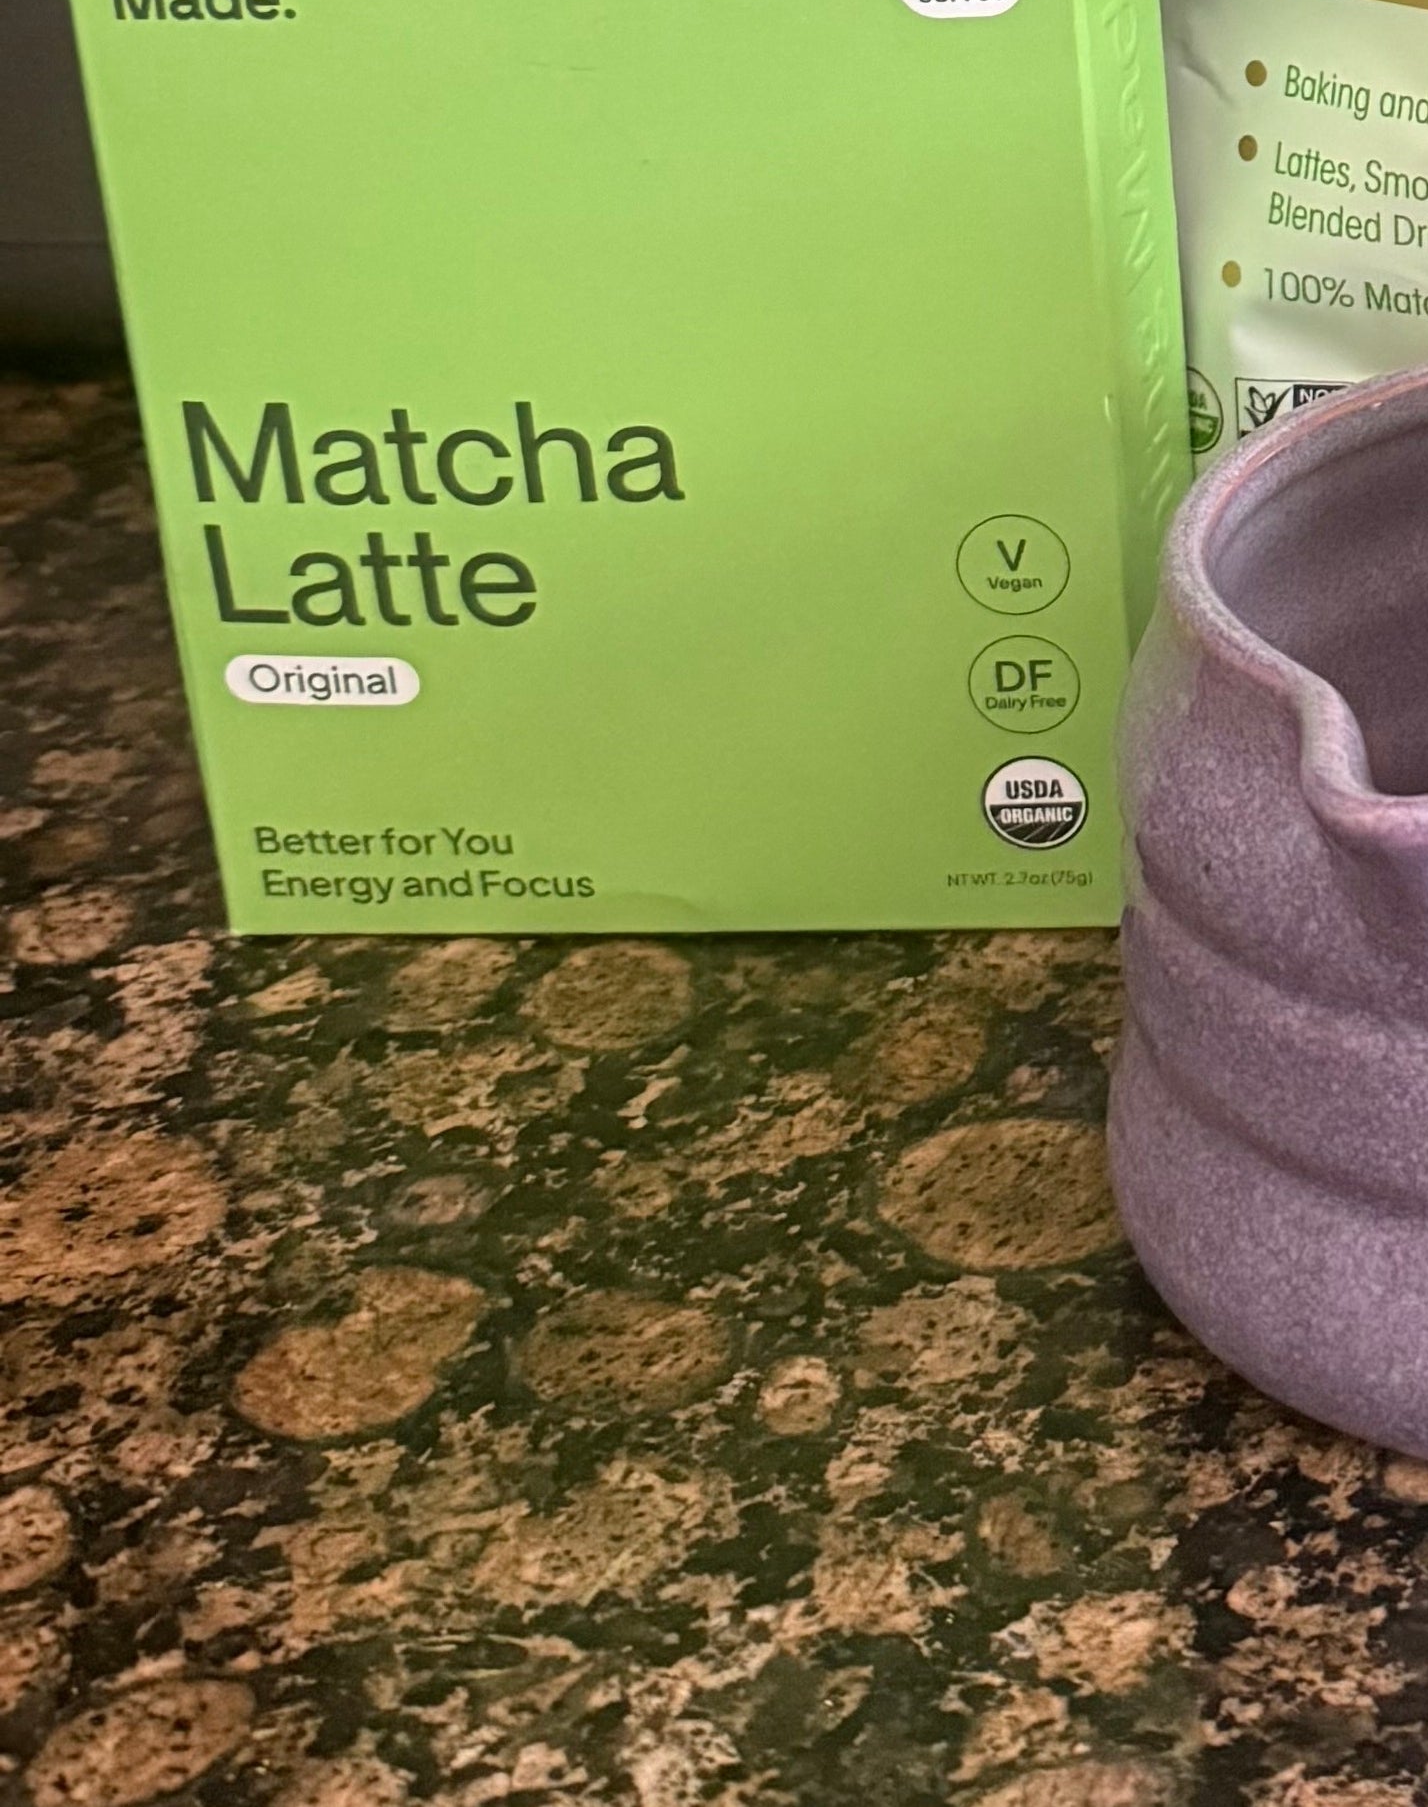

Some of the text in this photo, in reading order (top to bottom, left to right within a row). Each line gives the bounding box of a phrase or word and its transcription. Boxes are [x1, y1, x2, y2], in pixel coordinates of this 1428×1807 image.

[1284, 65, 1370, 121] Baking
[1274, 142, 1355, 192] Lattes,
[1268, 192, 1381, 243] Blended
[1264, 267, 1354, 308] 100%
[182, 401, 686, 506] Matcha
[997, 539, 1026, 571] V
[204, 524, 538, 627] Latte
[987, 576, 1043, 592] Vegan
[248, 664, 397, 701] Original
[995, 660, 1052, 693] DF
[986, 695, 1066, 713] Dairy Free
[1005, 779, 1064, 800] USDA
[1000, 806, 1073, 824] ORGANIC
[255, 827, 515, 855] Better for You
[262, 869, 596, 905] Energy and Focus
